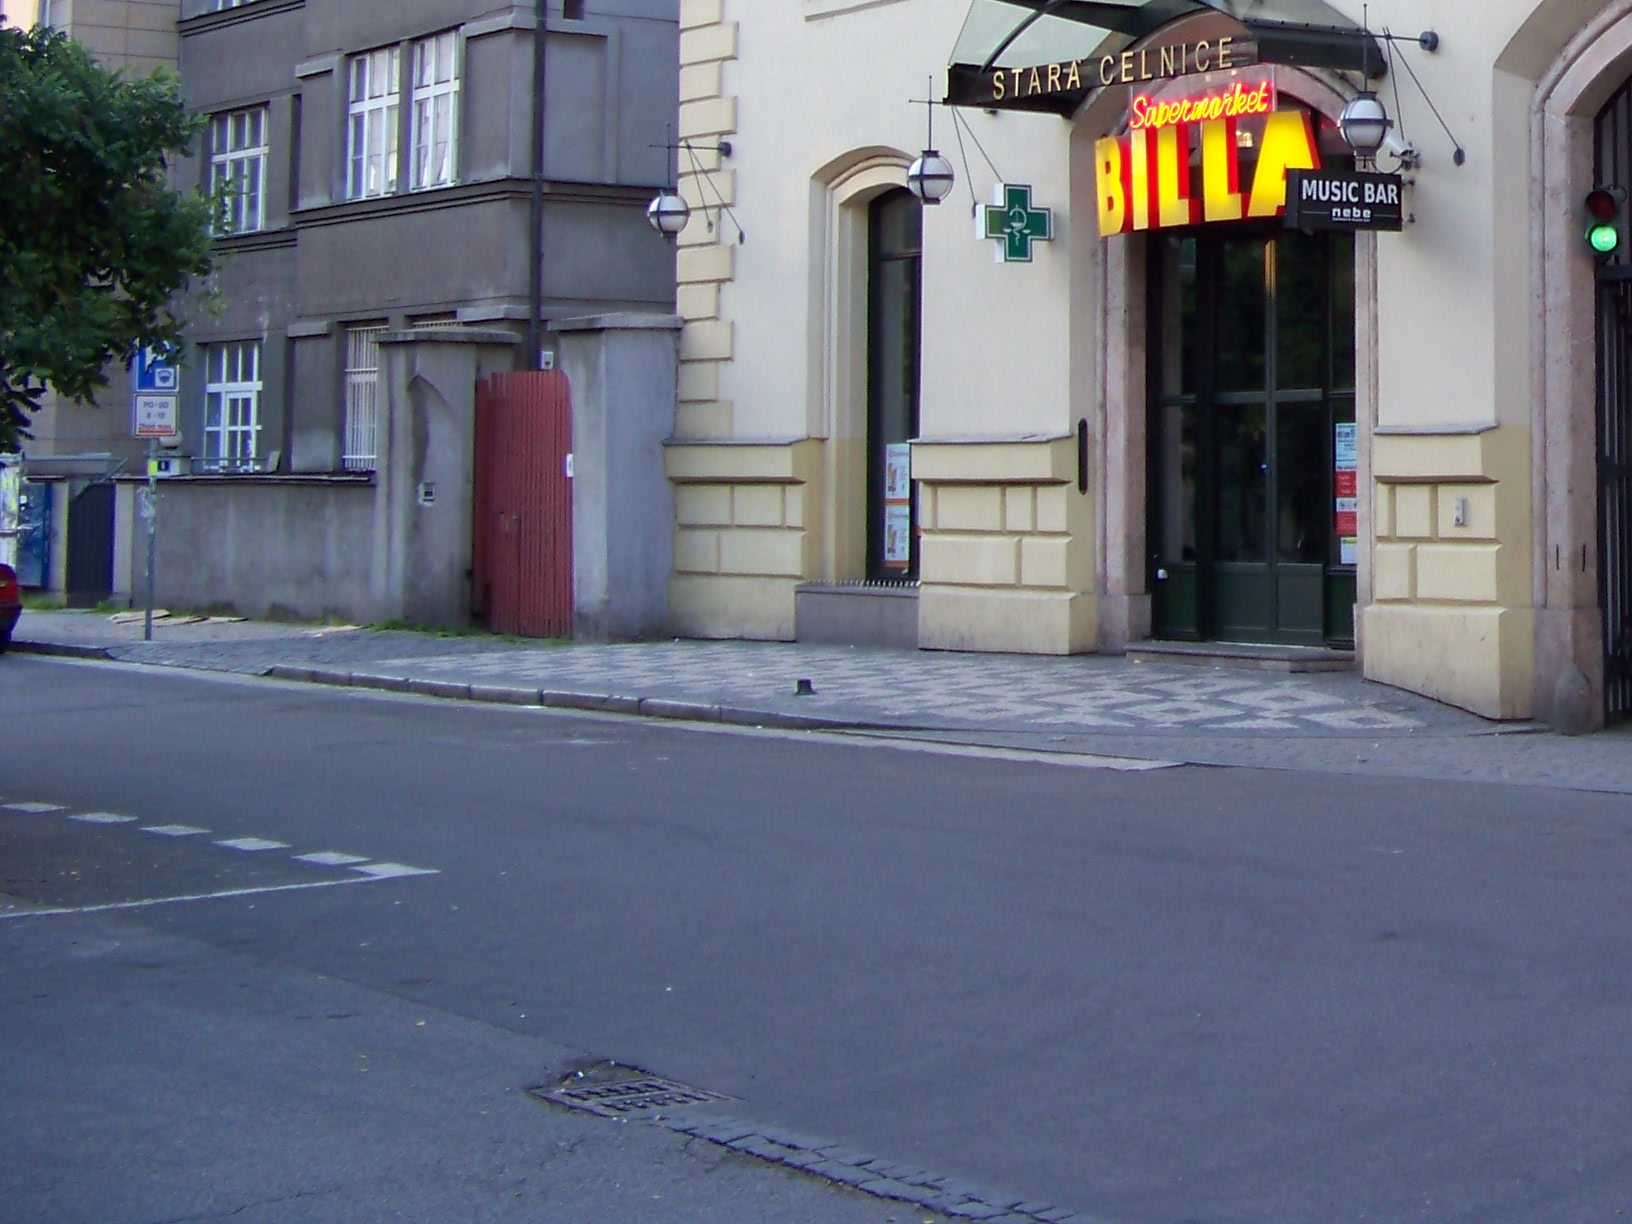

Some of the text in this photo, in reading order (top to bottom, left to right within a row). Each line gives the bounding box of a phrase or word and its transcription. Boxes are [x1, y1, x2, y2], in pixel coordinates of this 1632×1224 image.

[1099, 36, 1235, 86] CELNICE
[1130, 81, 1268, 129] Supermarket
[1095, 109, 1324, 237] BILLA
[1301, 178, 1399, 205] MUSIC BAR
[1331, 206, 1372, 219] nebe
